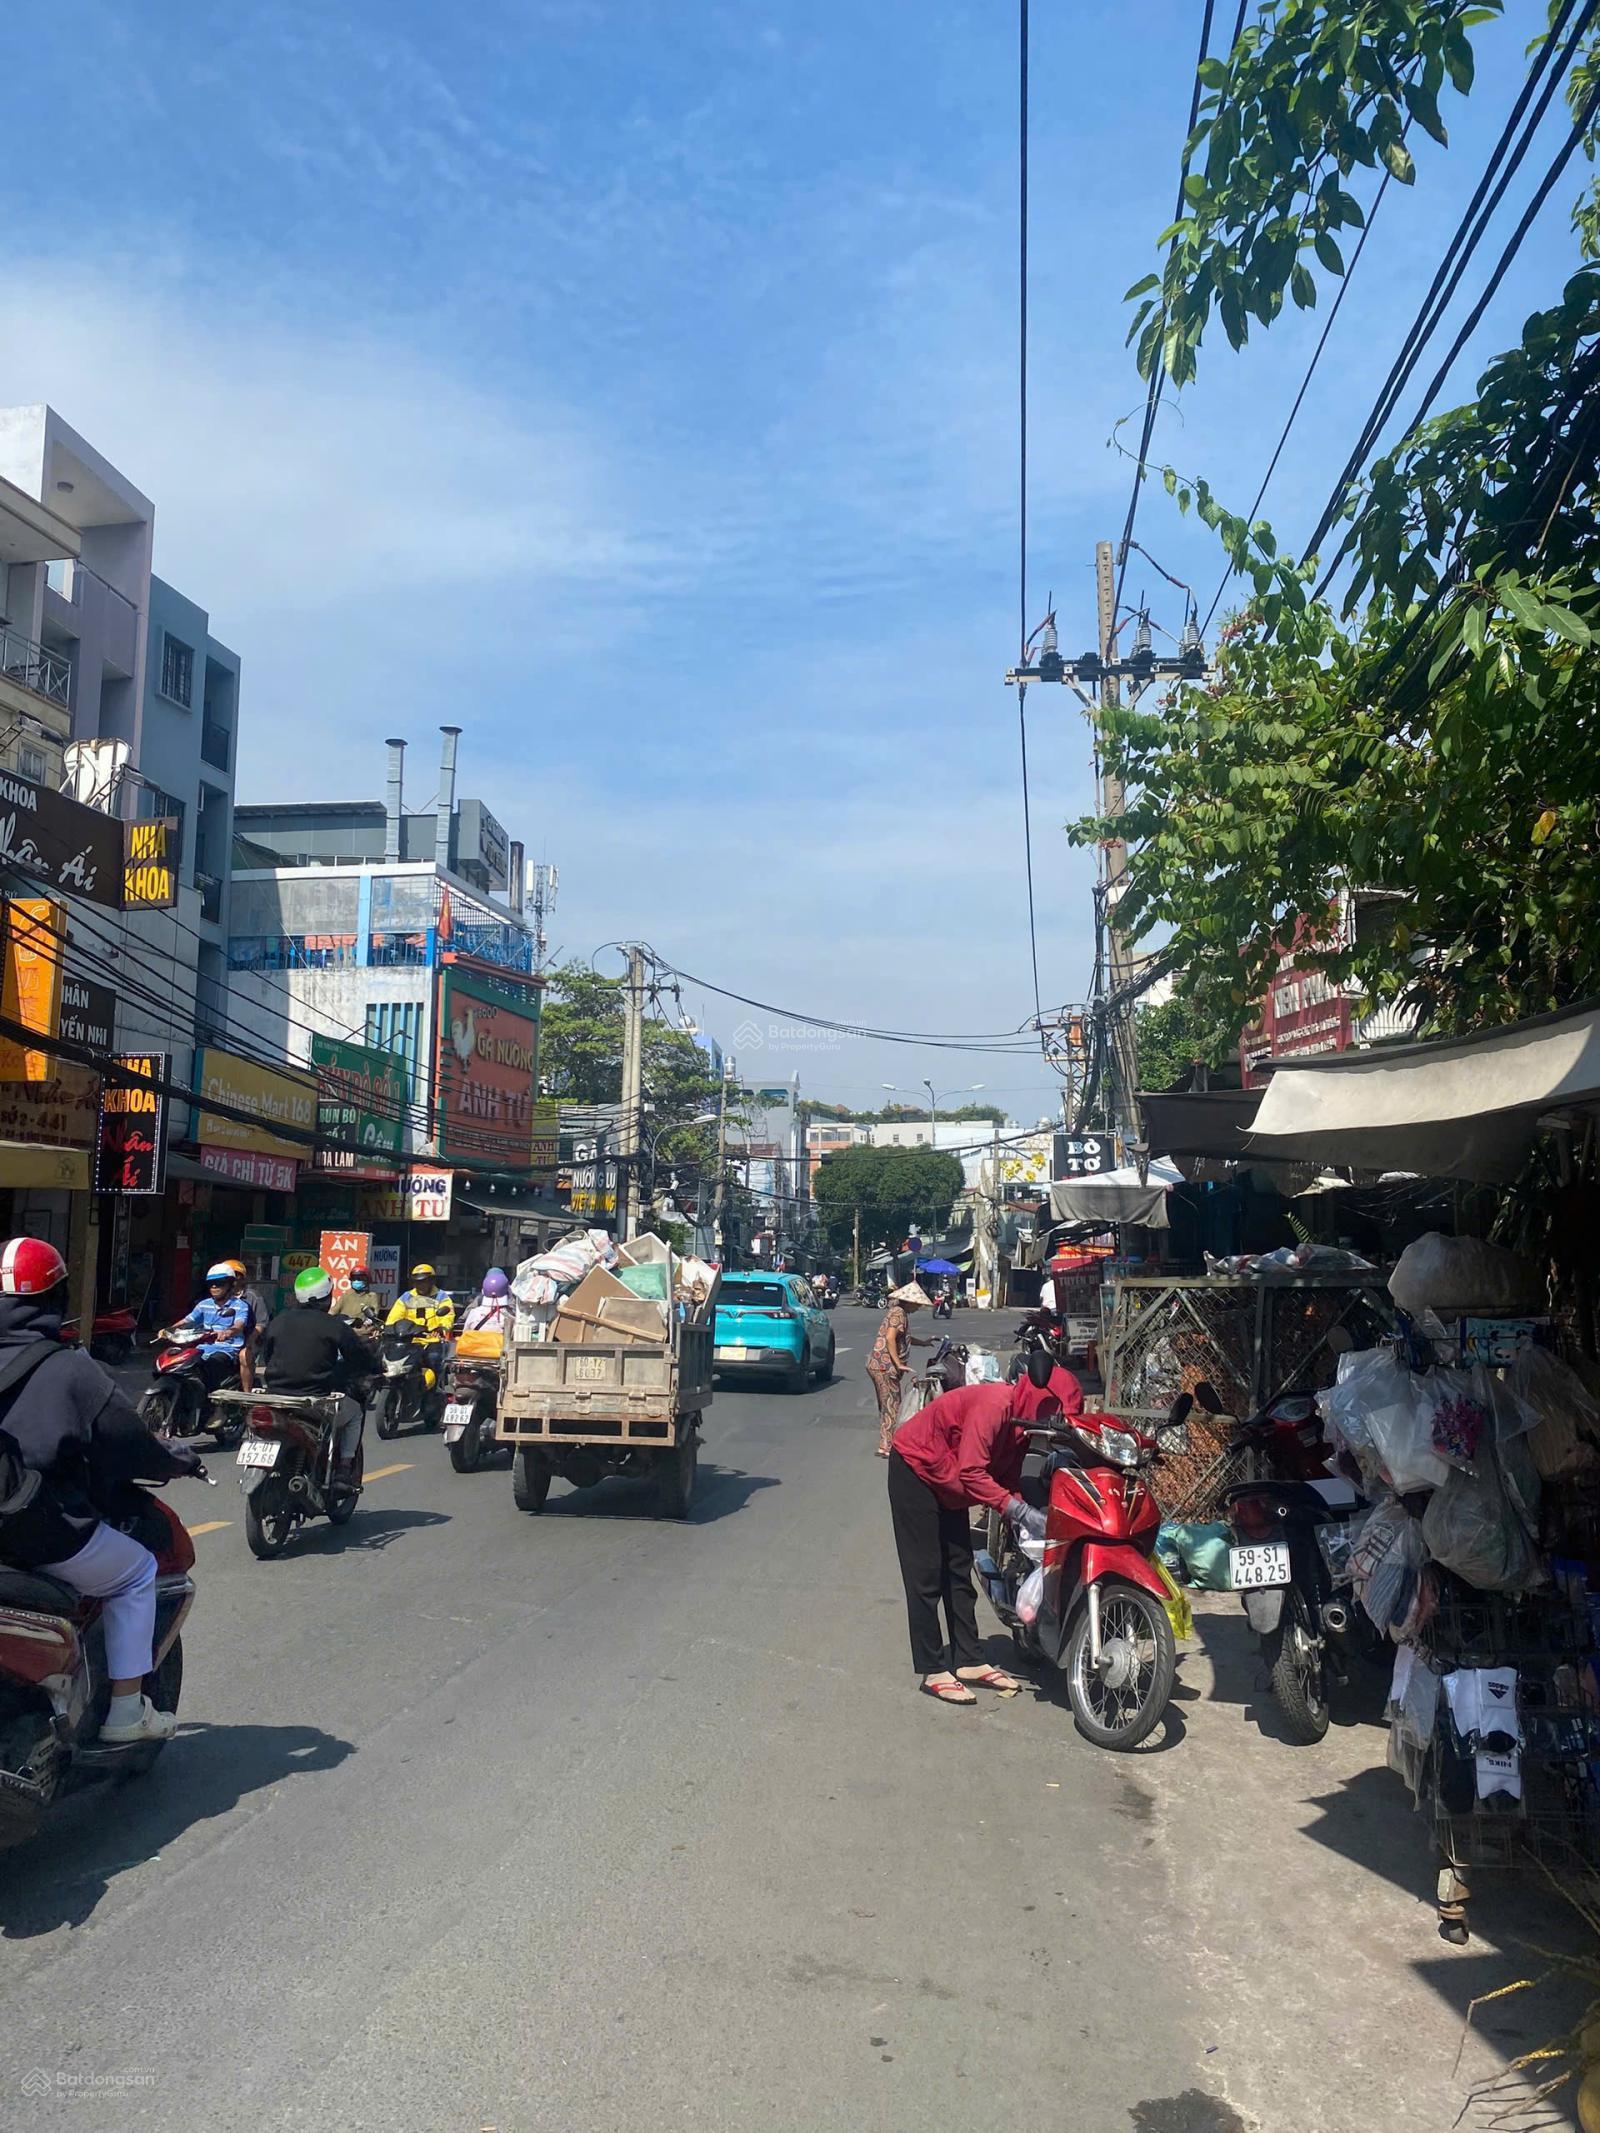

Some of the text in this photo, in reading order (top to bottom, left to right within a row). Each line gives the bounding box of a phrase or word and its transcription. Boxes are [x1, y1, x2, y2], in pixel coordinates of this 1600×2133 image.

[125, 867, 171, 902] KHOA
[104, 1088, 156, 1113] KHOA
[208, 1077, 312, 1124] Chinese Mart 168
[1067, 1138, 1101, 1155] BÒ
[1067, 1156, 1101, 1171] TƠ
[277, 1166, 292, 1190] 5K
[331, 1235, 358, 1251] ĂN
[327, 1255, 359, 1274] VẶT
[1234, 1563, 1287, 1585] 448.25
